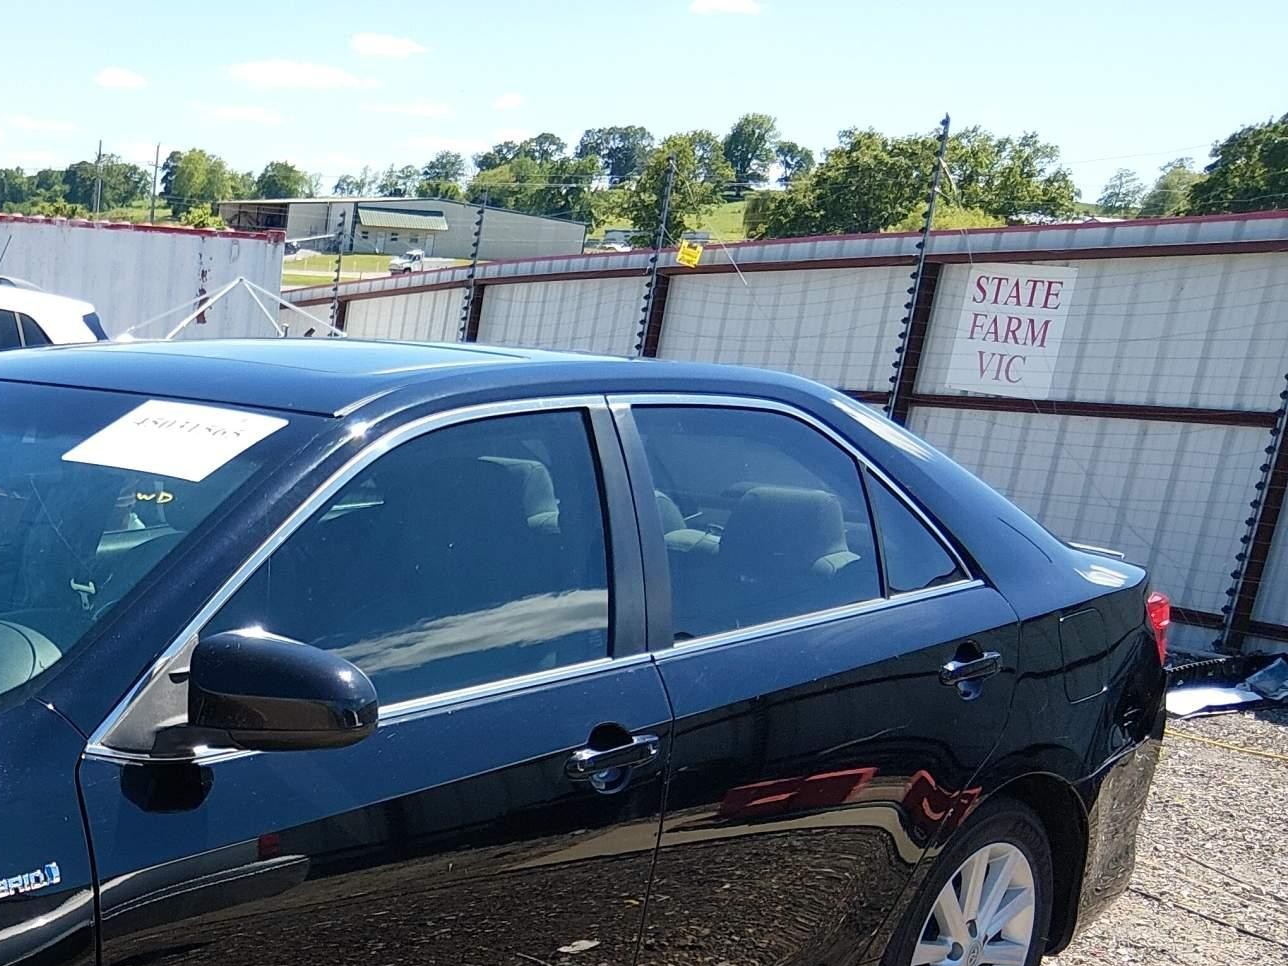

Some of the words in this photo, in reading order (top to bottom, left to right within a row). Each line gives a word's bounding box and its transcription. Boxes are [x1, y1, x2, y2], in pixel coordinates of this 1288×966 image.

[972, 275, 1064, 310] STATE
[968, 312, 1053, 348] FARM
[977, 350, 1027, 384] VIC
